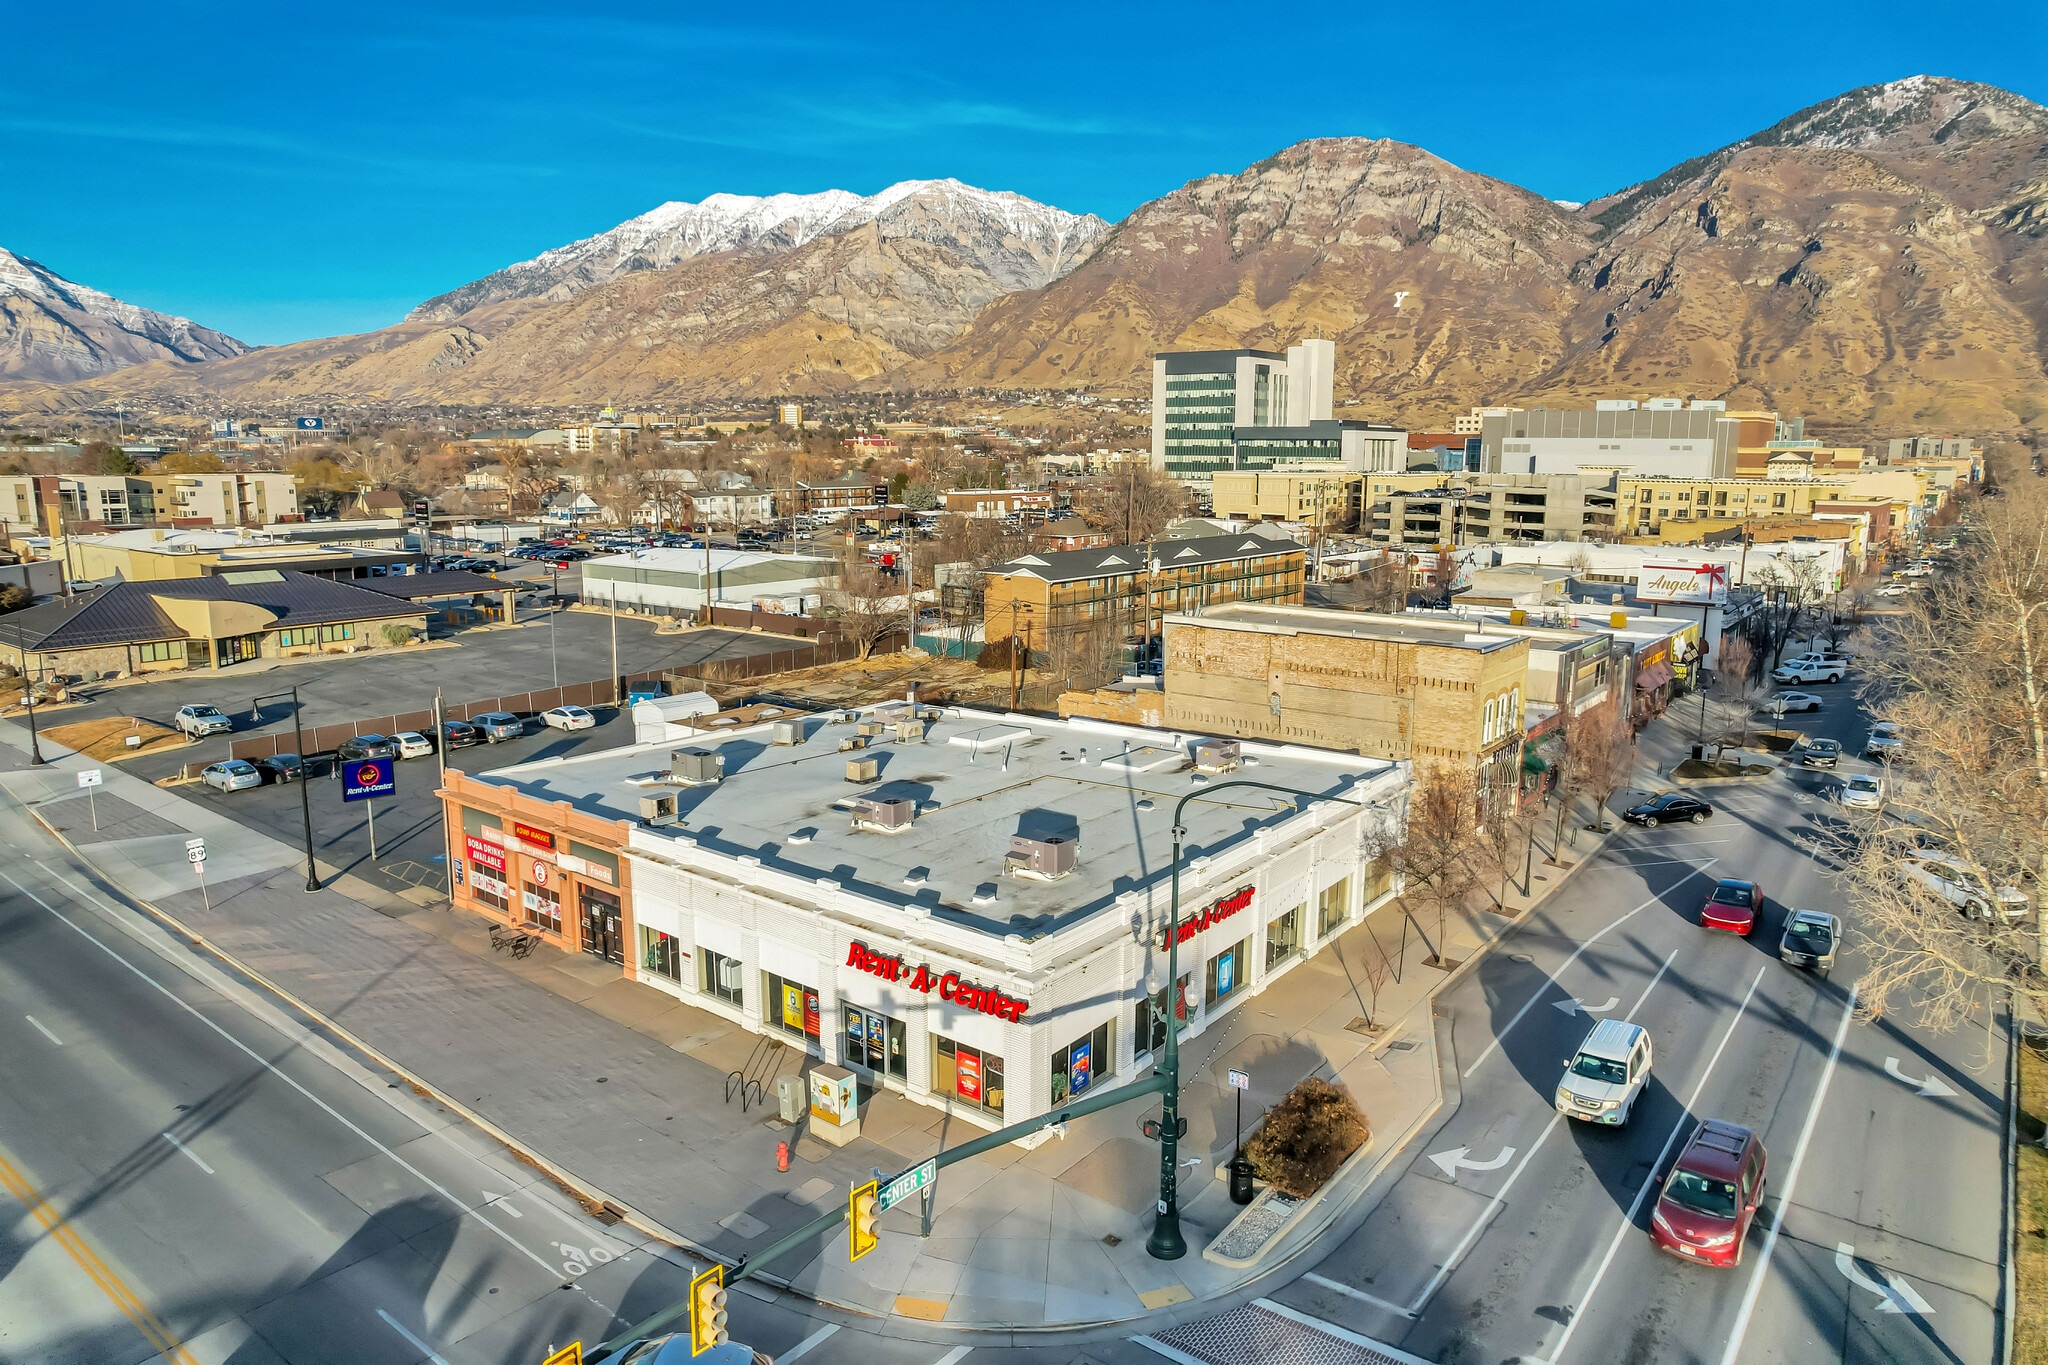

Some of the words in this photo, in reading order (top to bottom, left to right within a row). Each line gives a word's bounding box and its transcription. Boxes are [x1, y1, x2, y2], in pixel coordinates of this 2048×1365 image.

[1648, 575, 1700, 596] Angels
[190, 849, 204, 860] 89
[467, 838, 483, 851] BOBA
[483, 844, 505, 859] DRINKS
[472, 850, 502, 868] AVAILABLE
[589, 864, 611, 879] Foods
[790, 990, 797, 1006] 6
[880, 1173, 918, 1208] CENTER
[920, 1164, 933, 1183] ST
